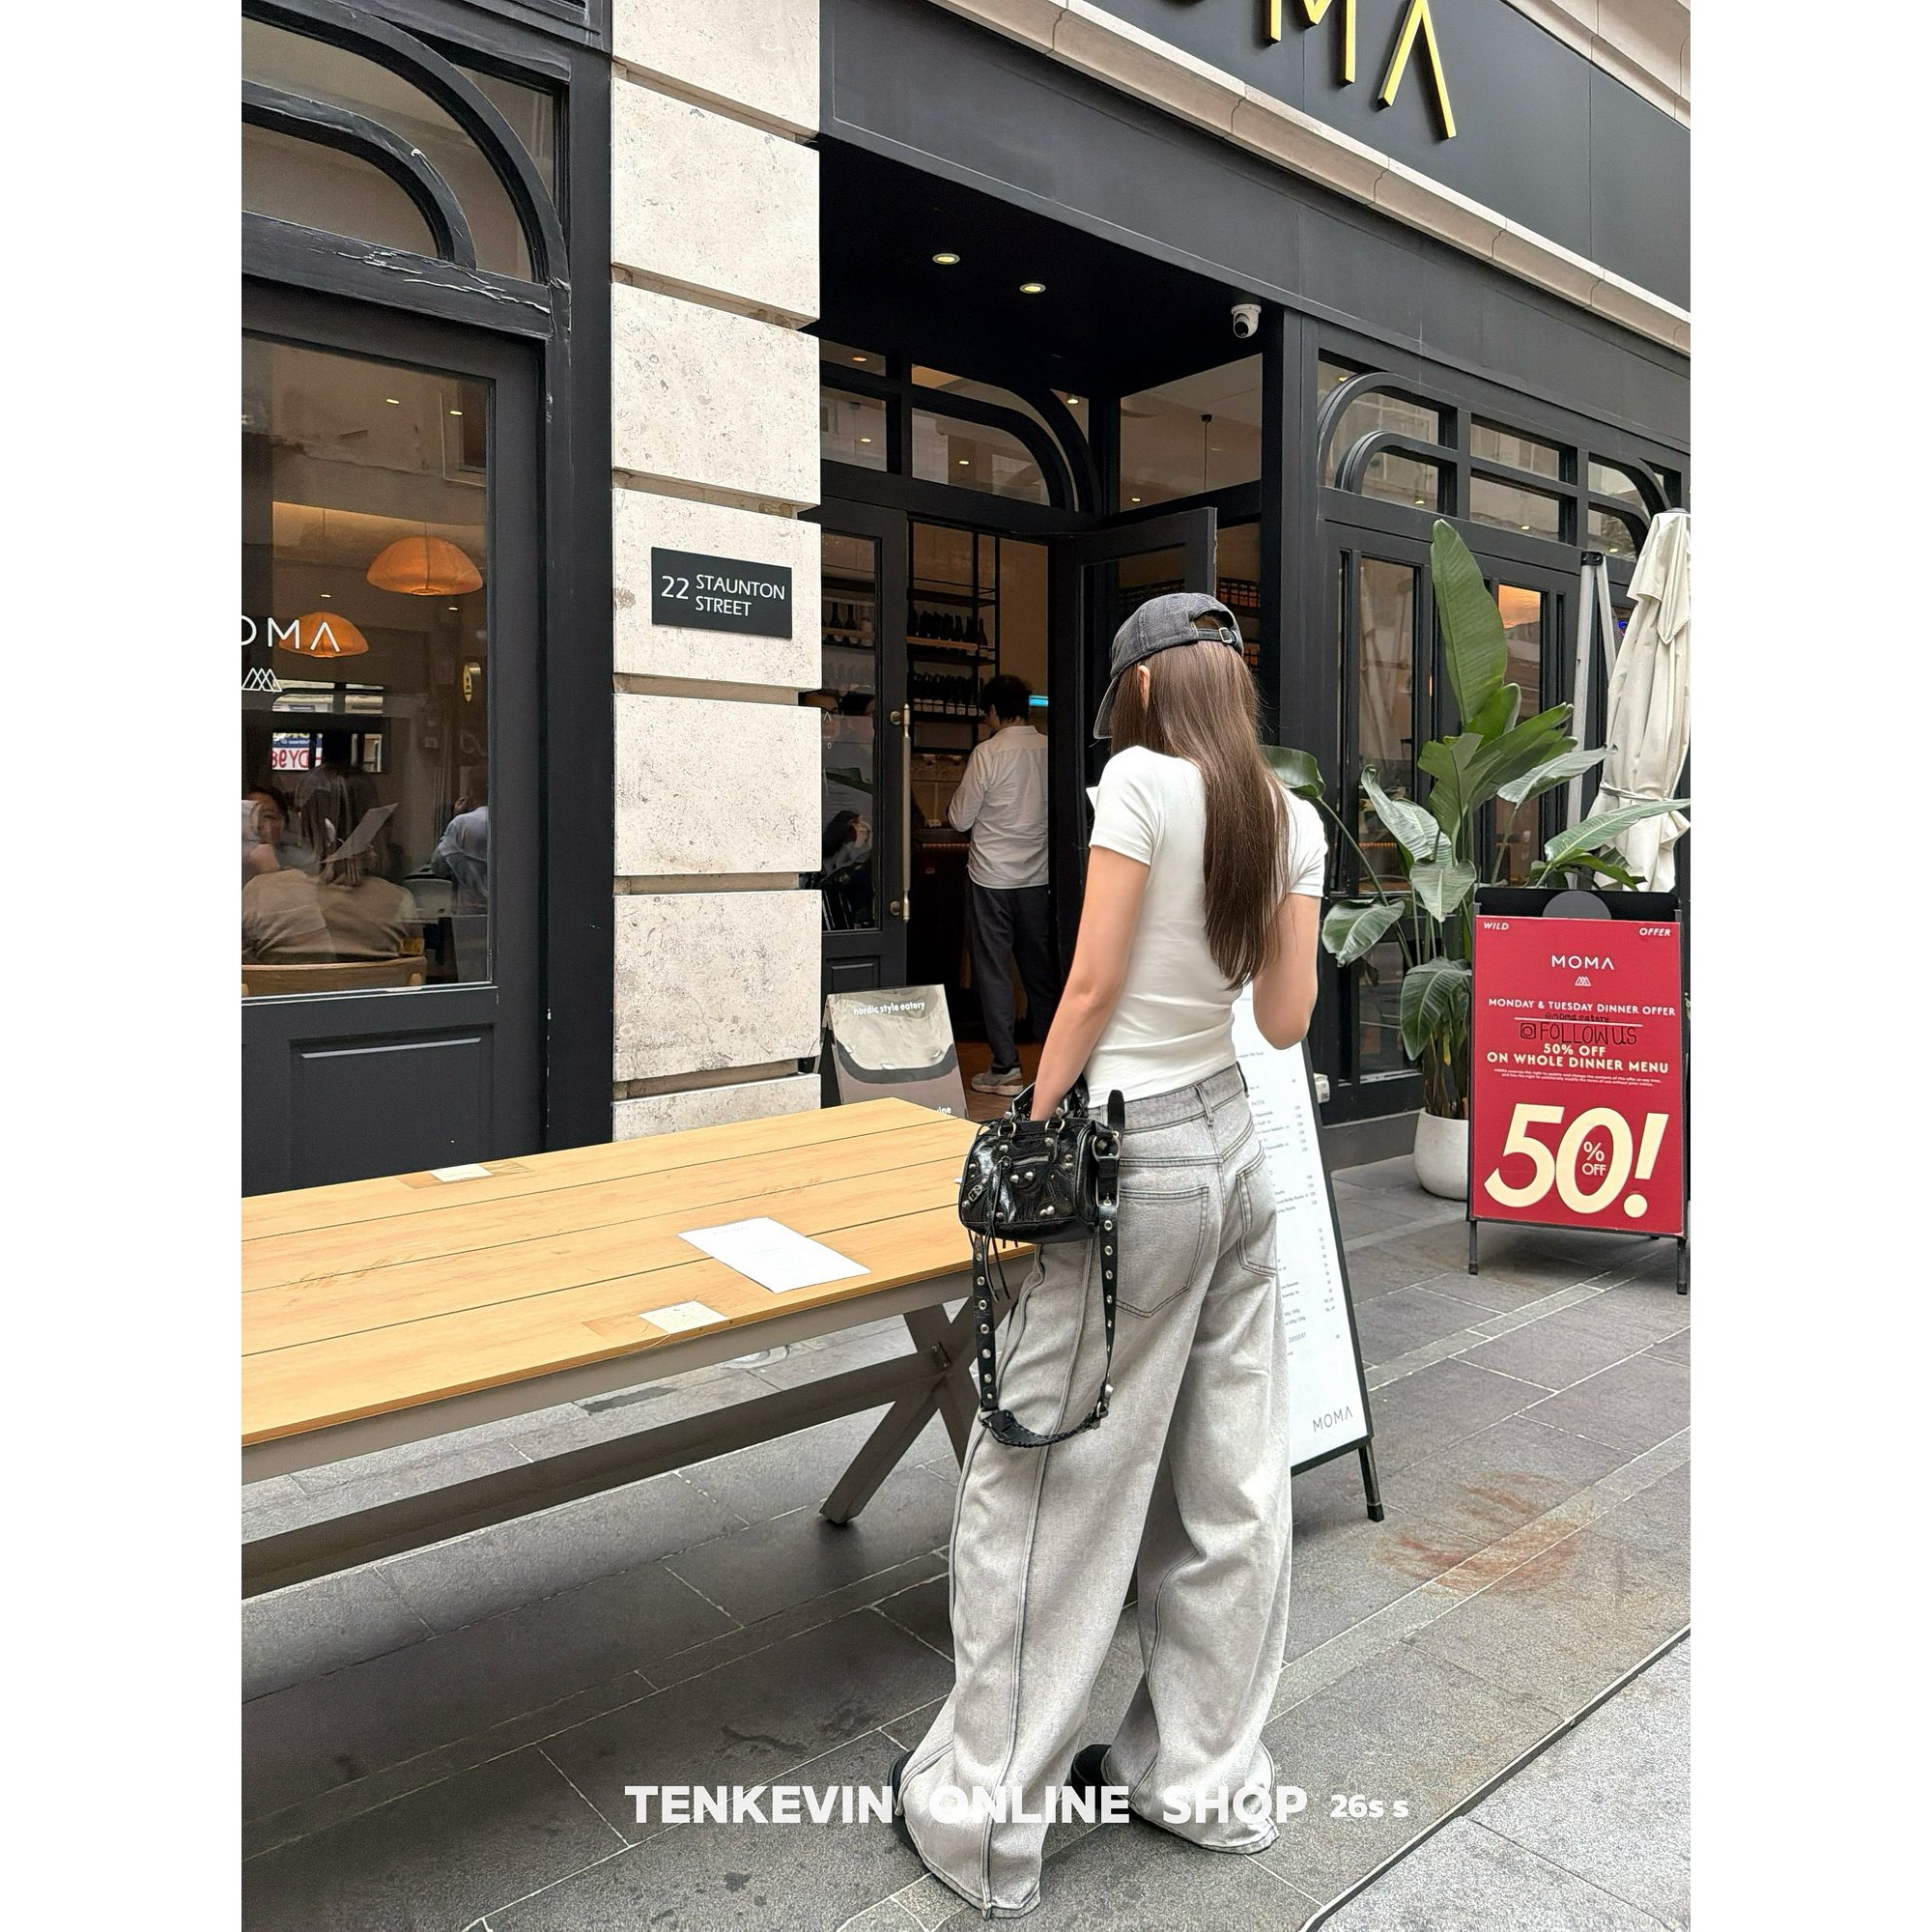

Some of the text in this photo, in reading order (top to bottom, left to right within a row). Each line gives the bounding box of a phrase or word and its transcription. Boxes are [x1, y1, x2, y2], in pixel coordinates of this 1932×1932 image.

[661, 574, 785, 601] 22 STAUNTON
[696, 595, 752, 616] STREET
[1483, 922, 1509, 931] WILD
[1639, 927, 1671, 937] OFFER
[1551, 954, 1614, 971] MOMA
[853, 1001, 925, 1015] nordic style eatery
[1489, 998, 1676, 1016] MONDAY & TUESDAY DINNER OFFER
[1544, 1043, 1606, 1056] 50% OFF
[1487, 1051, 1669, 1073] ON WHOLE DINNER MENU
[1583, 1141, 1605, 1161] %
[1484, 1103, 1669, 1218] 50!
[1581, 1163, 1606, 1177] OFF
[1313, 1406, 1352, 1433] MOMA
